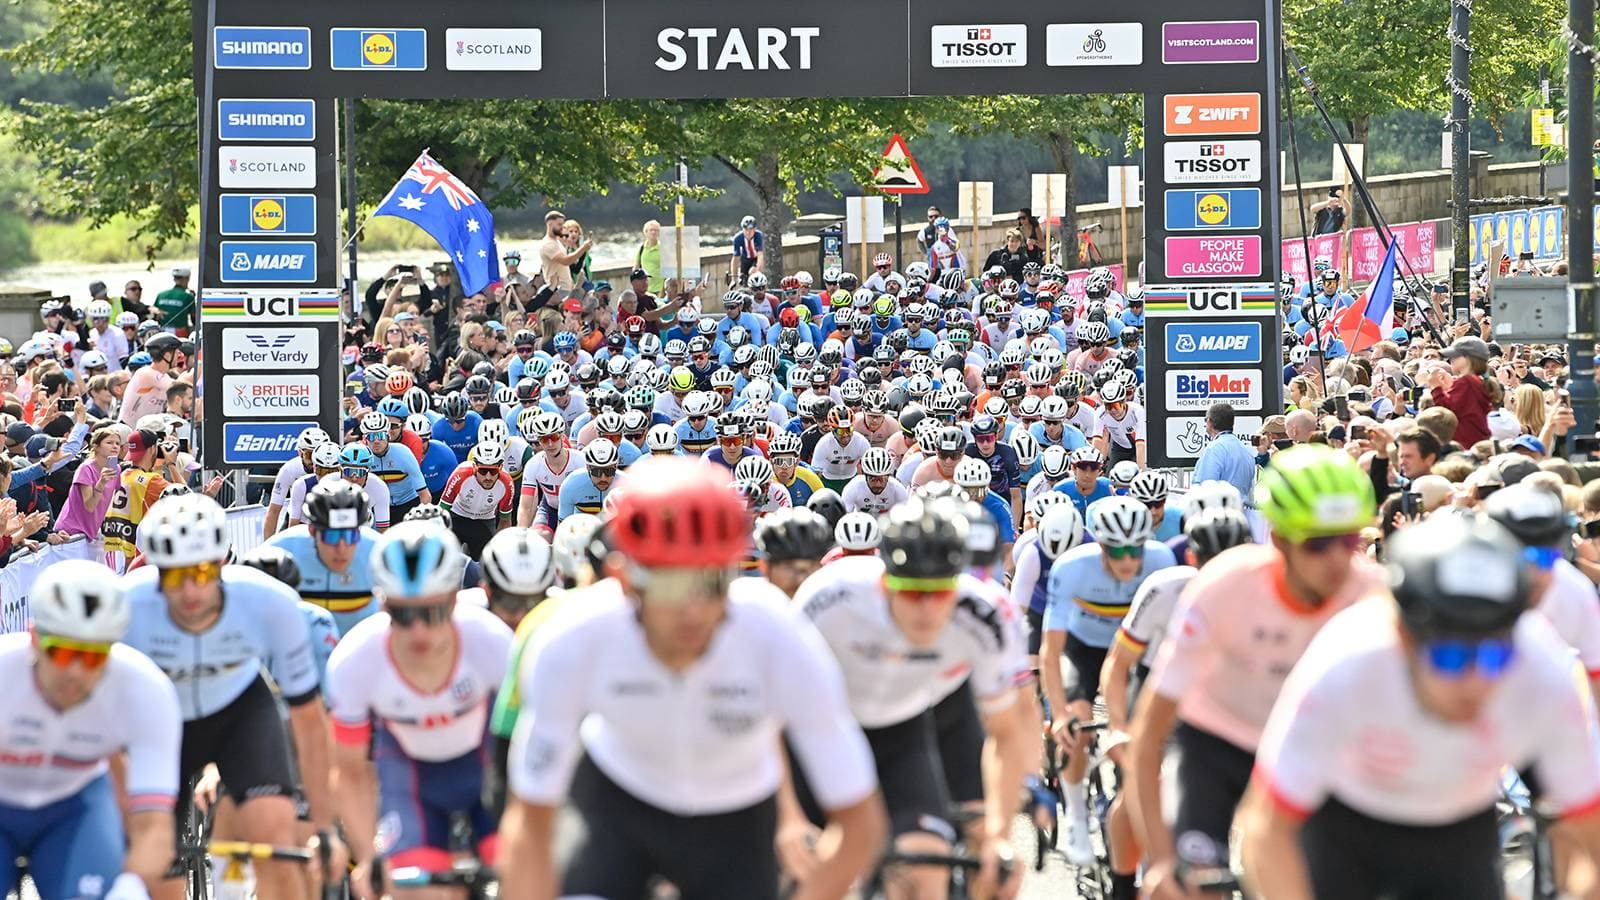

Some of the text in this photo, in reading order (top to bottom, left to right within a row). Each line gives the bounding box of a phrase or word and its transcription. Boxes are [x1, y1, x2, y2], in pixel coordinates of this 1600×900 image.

[222, 40, 303, 55] SHIMANO
[467, 44, 532, 55] SCOTLAND
[654, 26, 820, 72] START
[942, 42, 1016, 57] TISSOT
[1167, 37, 1254, 48] VISITSCOTLAND.COM
[228, 113, 306, 127] SHIMANO
[1198, 106, 1251, 121] ZWIFT
[239, 161, 306, 173] SCOTLAND
[1175, 158, 1250, 172] TISSOT
[1200, 239, 1244, 251] PEOPLE
[253, 254, 305, 270] MAPEI
[1210, 251, 1244, 262] MAKE
[1182, 262, 1245, 274] GLASGOW
[246, 297, 294, 316] UCI
[1189, 291, 1237, 310] UCI
[1198, 335, 1251, 351] MAPEI
[232, 350, 309, 364] Peter Vardy
[252, 384, 310, 396] BRITISH
[1176, 374, 1251, 398] BigMat
[252, 396, 310, 408] CYCLING
[233, 434, 299, 452] Santin
